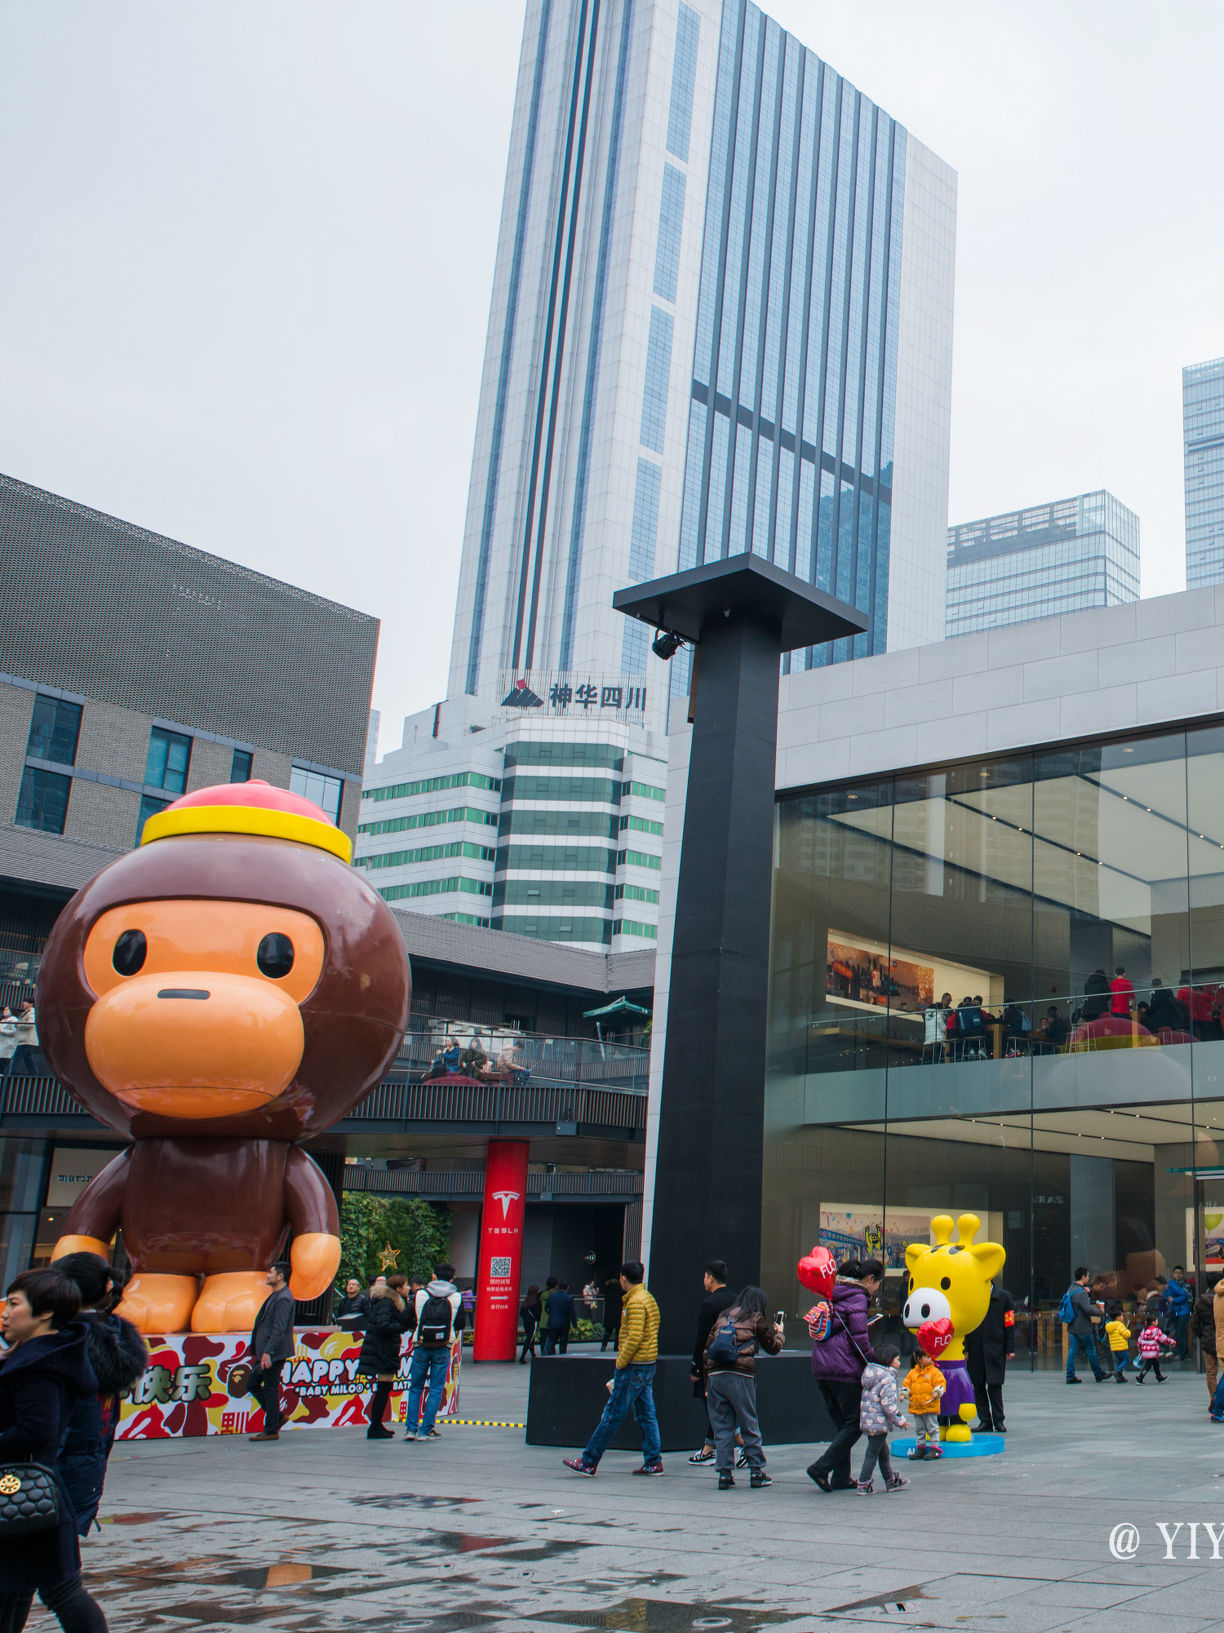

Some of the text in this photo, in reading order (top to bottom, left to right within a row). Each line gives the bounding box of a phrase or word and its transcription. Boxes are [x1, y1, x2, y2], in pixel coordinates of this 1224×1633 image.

[549, 683, 647, 711] 神华四川
[488, 1227, 519, 1235] TESLA
[120, 1364, 213, 1405] 快乐
